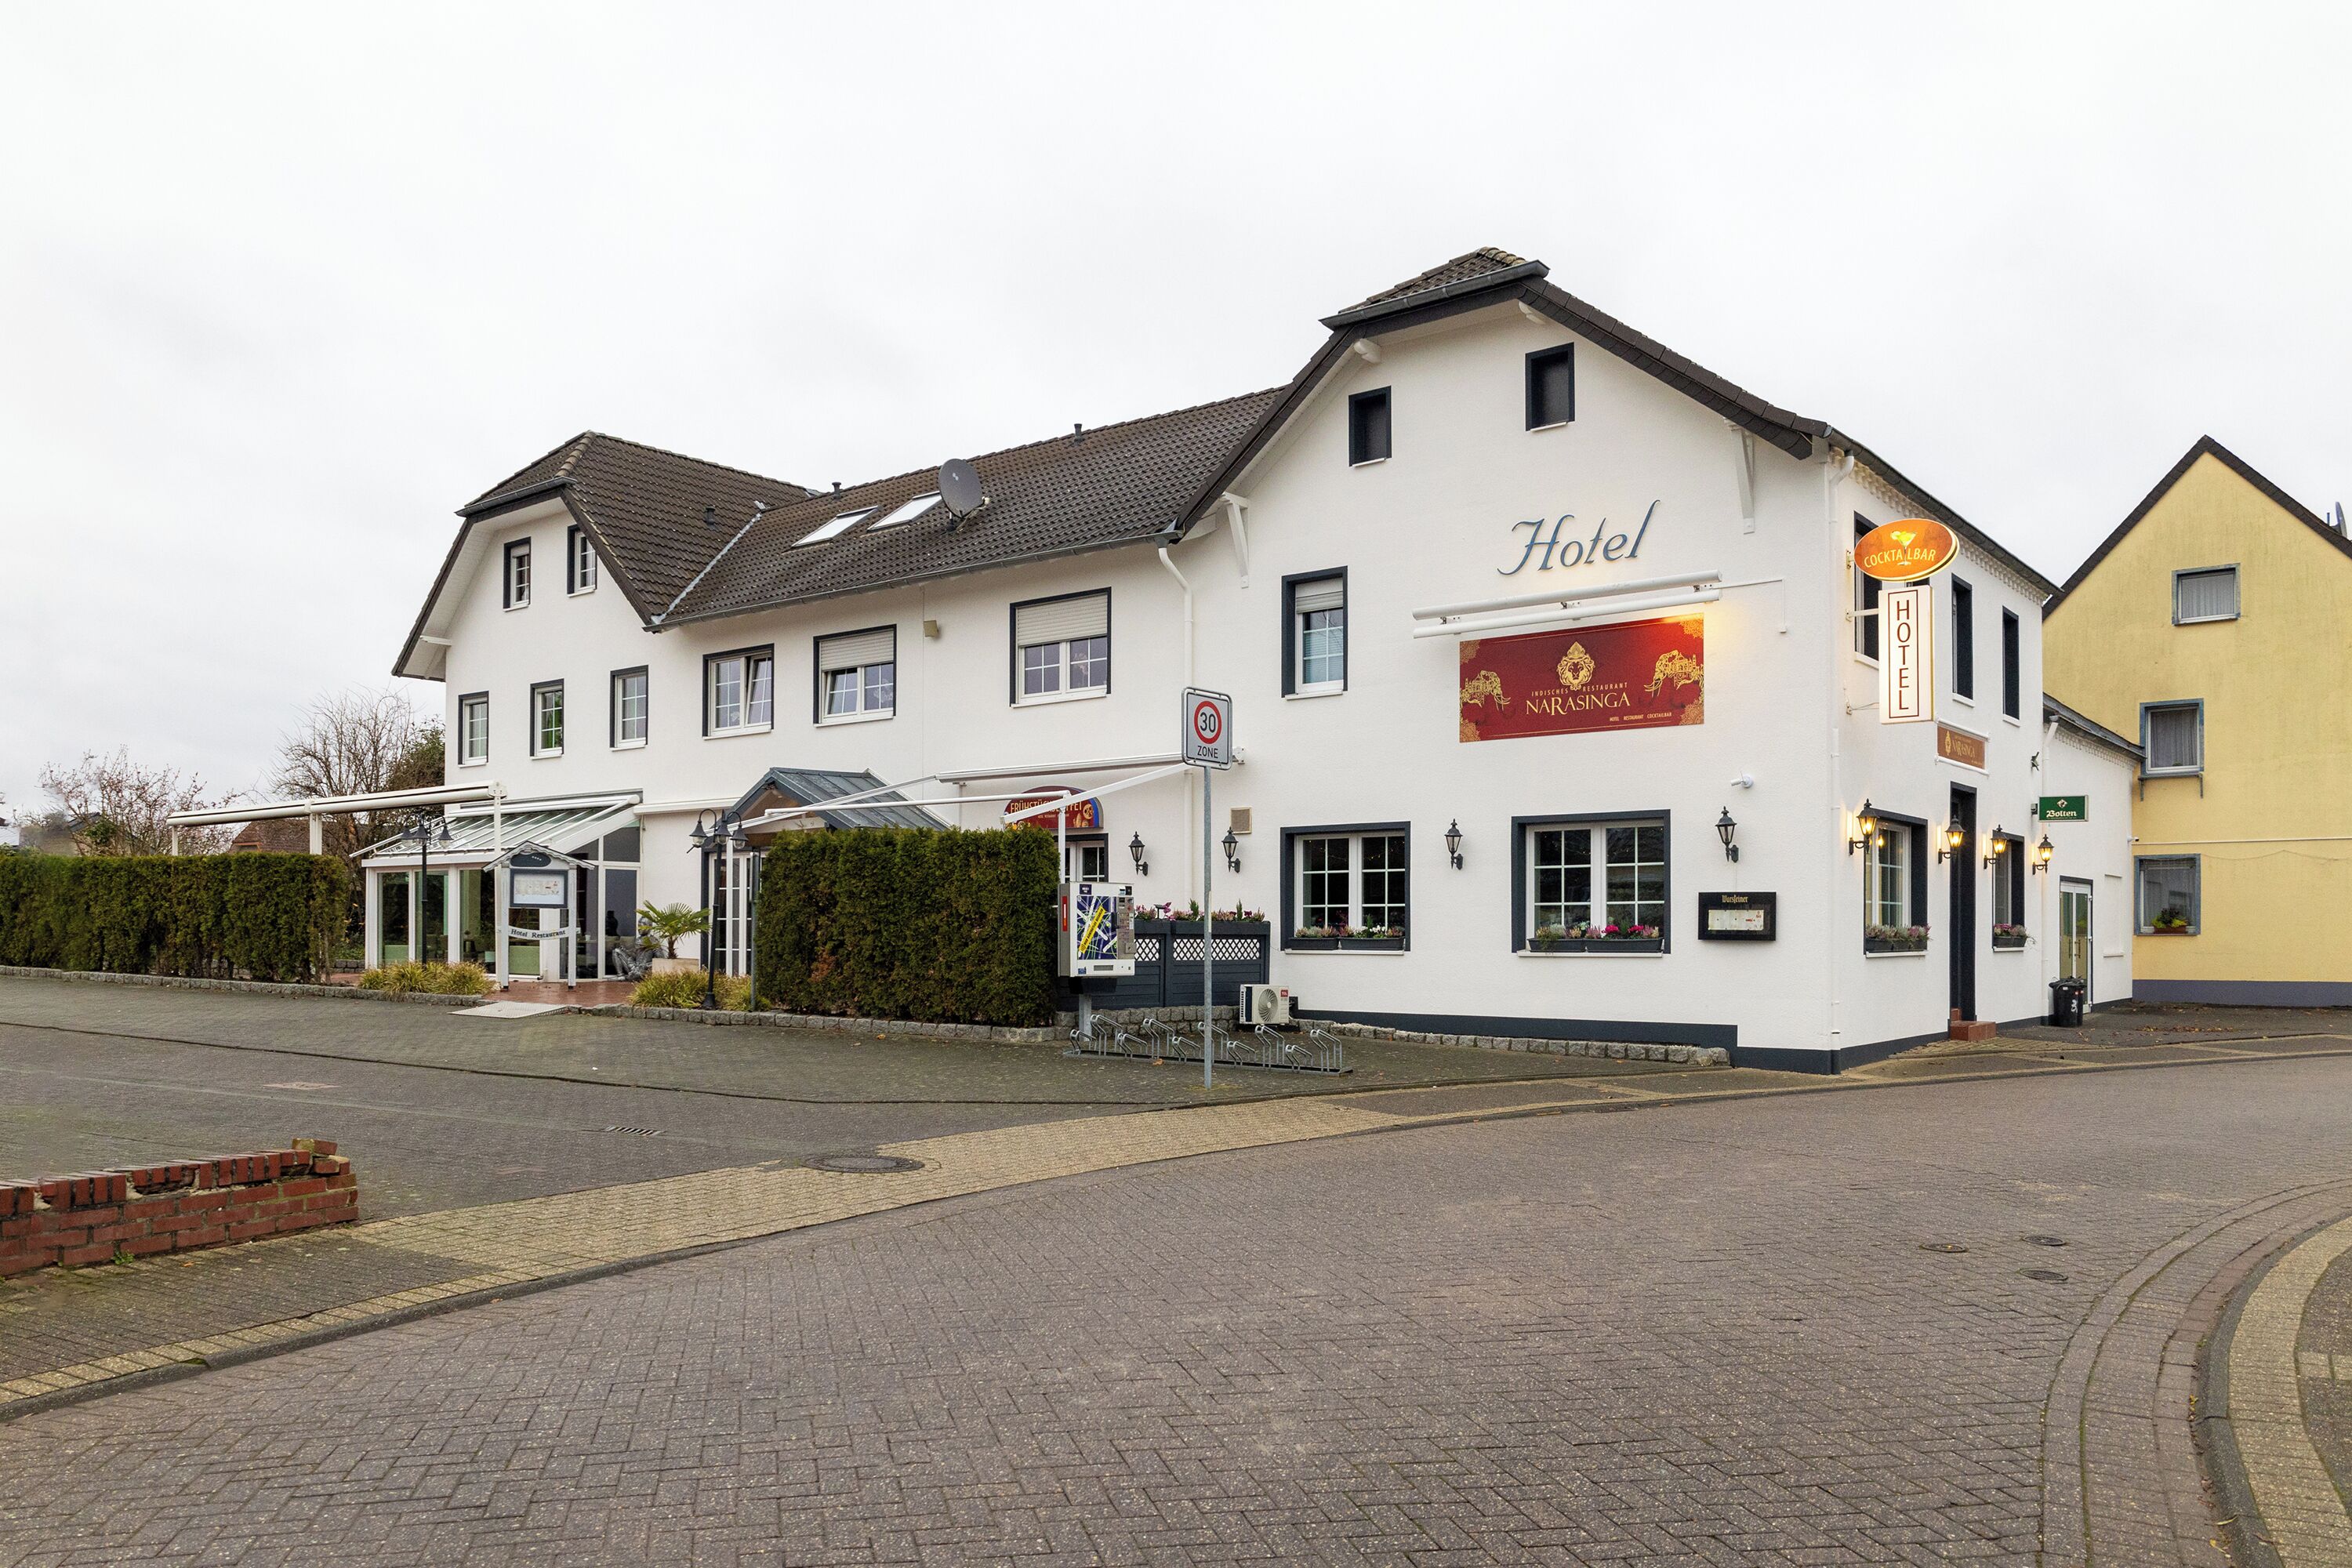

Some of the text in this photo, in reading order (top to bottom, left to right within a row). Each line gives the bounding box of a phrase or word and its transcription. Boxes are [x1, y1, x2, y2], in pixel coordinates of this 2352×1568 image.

[1497, 499, 1661, 575] Hotel
[1896, 600, 1911, 710] HOTEL
[1531, 682, 1628, 697] INDISCHES RESTAURANT
[1526, 691, 1631, 716] NARASINGA
[1200, 712, 1216, 733] 30
[1197, 745, 1218, 759] ZONE
[511, 928, 566, 938] Hotel Restaurant
